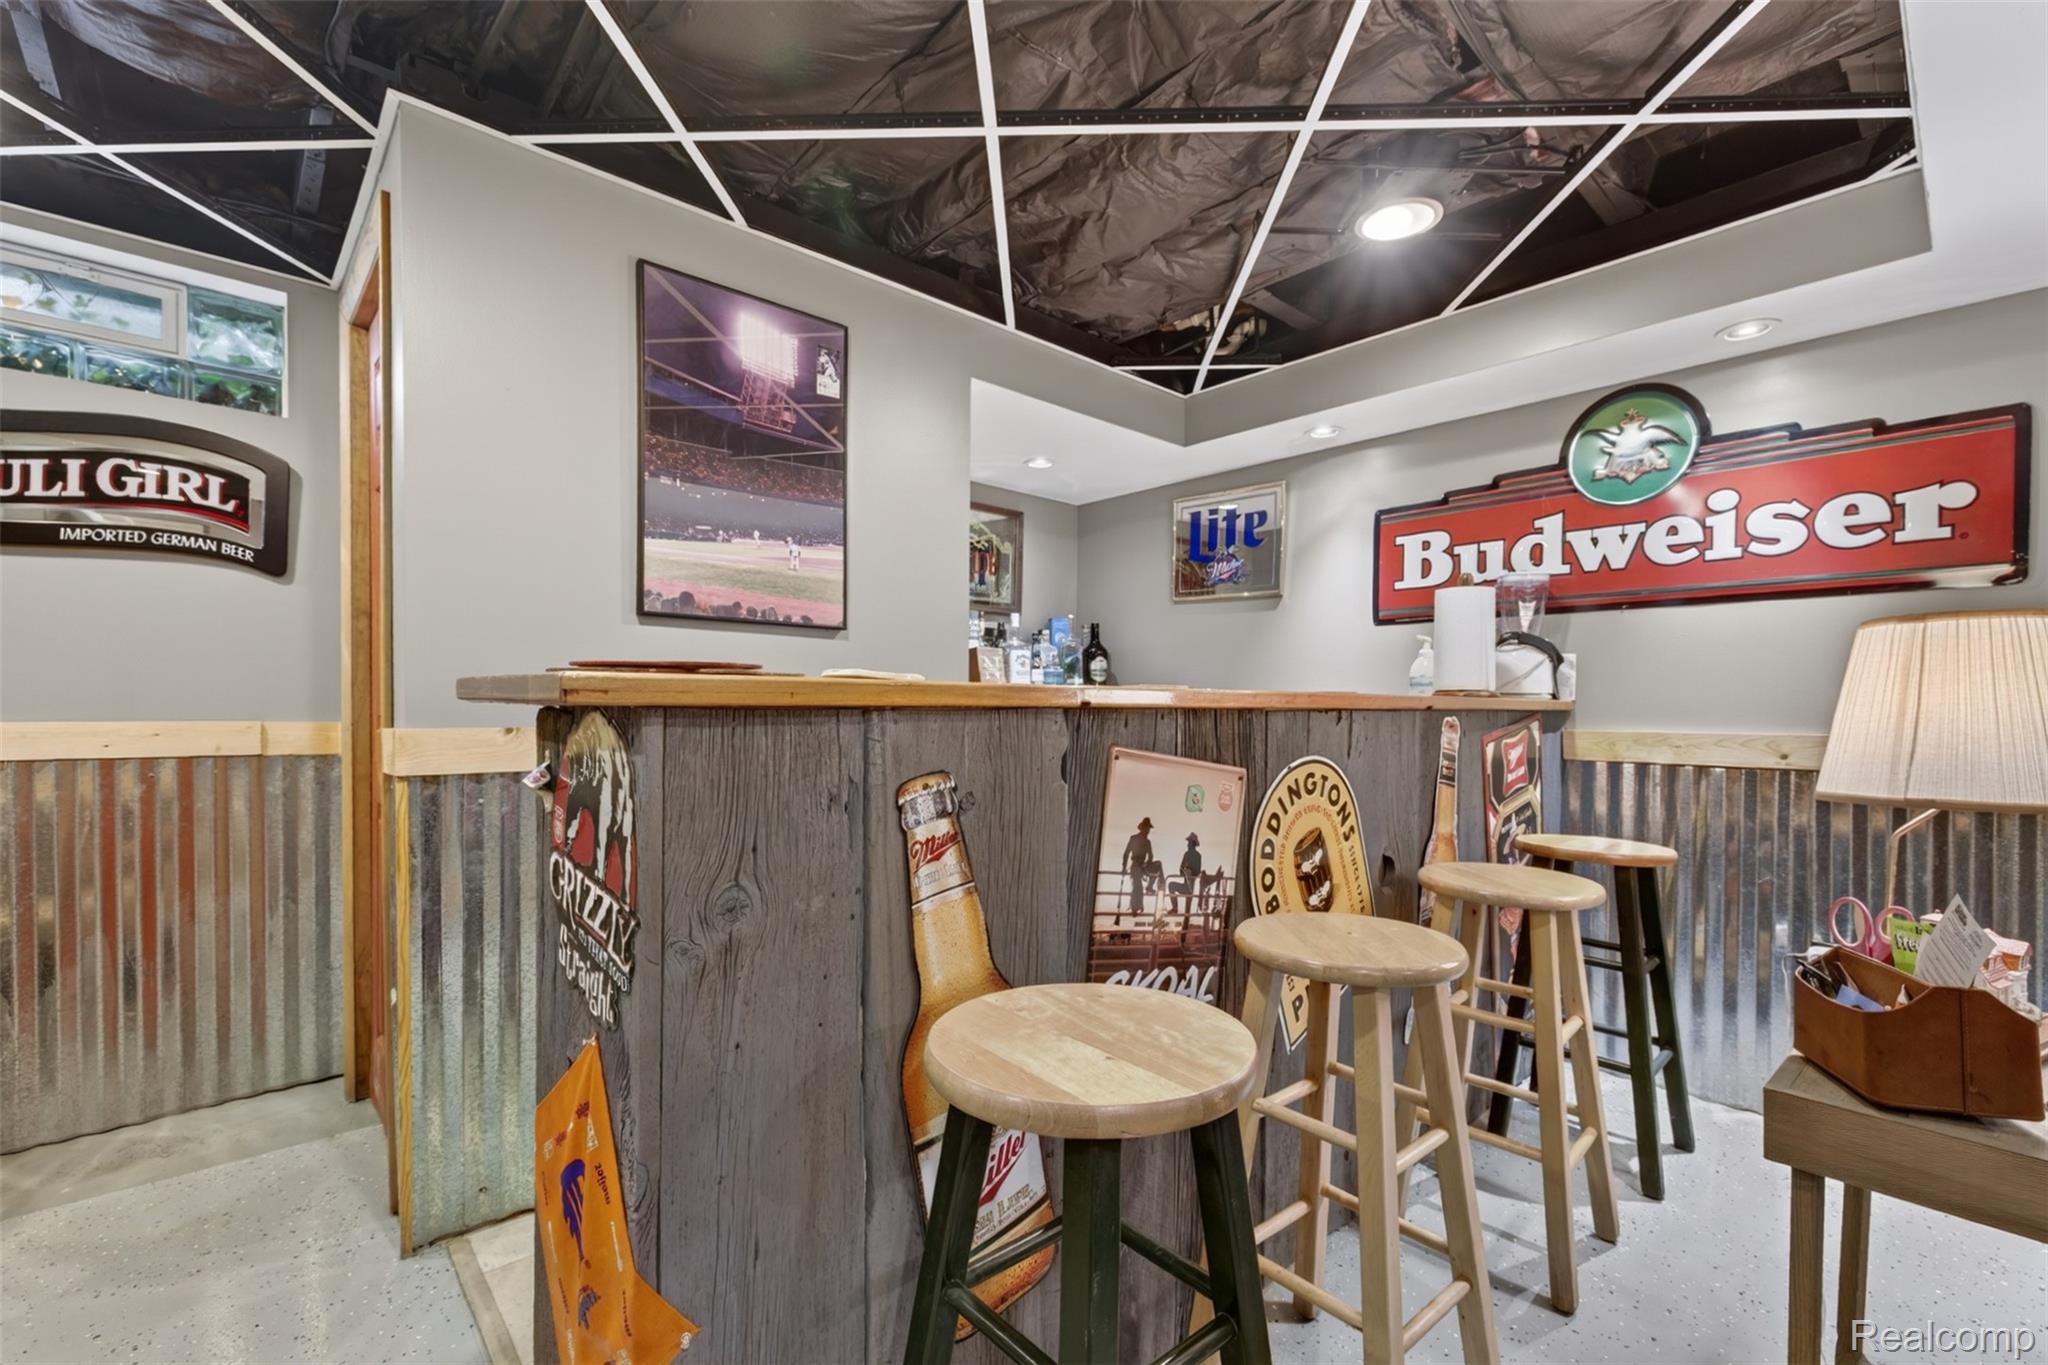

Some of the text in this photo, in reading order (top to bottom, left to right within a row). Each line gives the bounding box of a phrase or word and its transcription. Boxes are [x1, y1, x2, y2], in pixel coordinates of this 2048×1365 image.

[59, 527, 255, 562] IMPORTED GERMAN BEER
[1188, 507, 1268, 564] Lite
[1393, 480, 1979, 592] Budweiser
[910, 831, 960, 871] Miller
[1261, 772, 1356, 914] BODDINGTONS
[549, 850, 637, 970] GRIZZLY
[559, 923, 615, 1023] Straight
[981, 1131, 1026, 1192] iller
